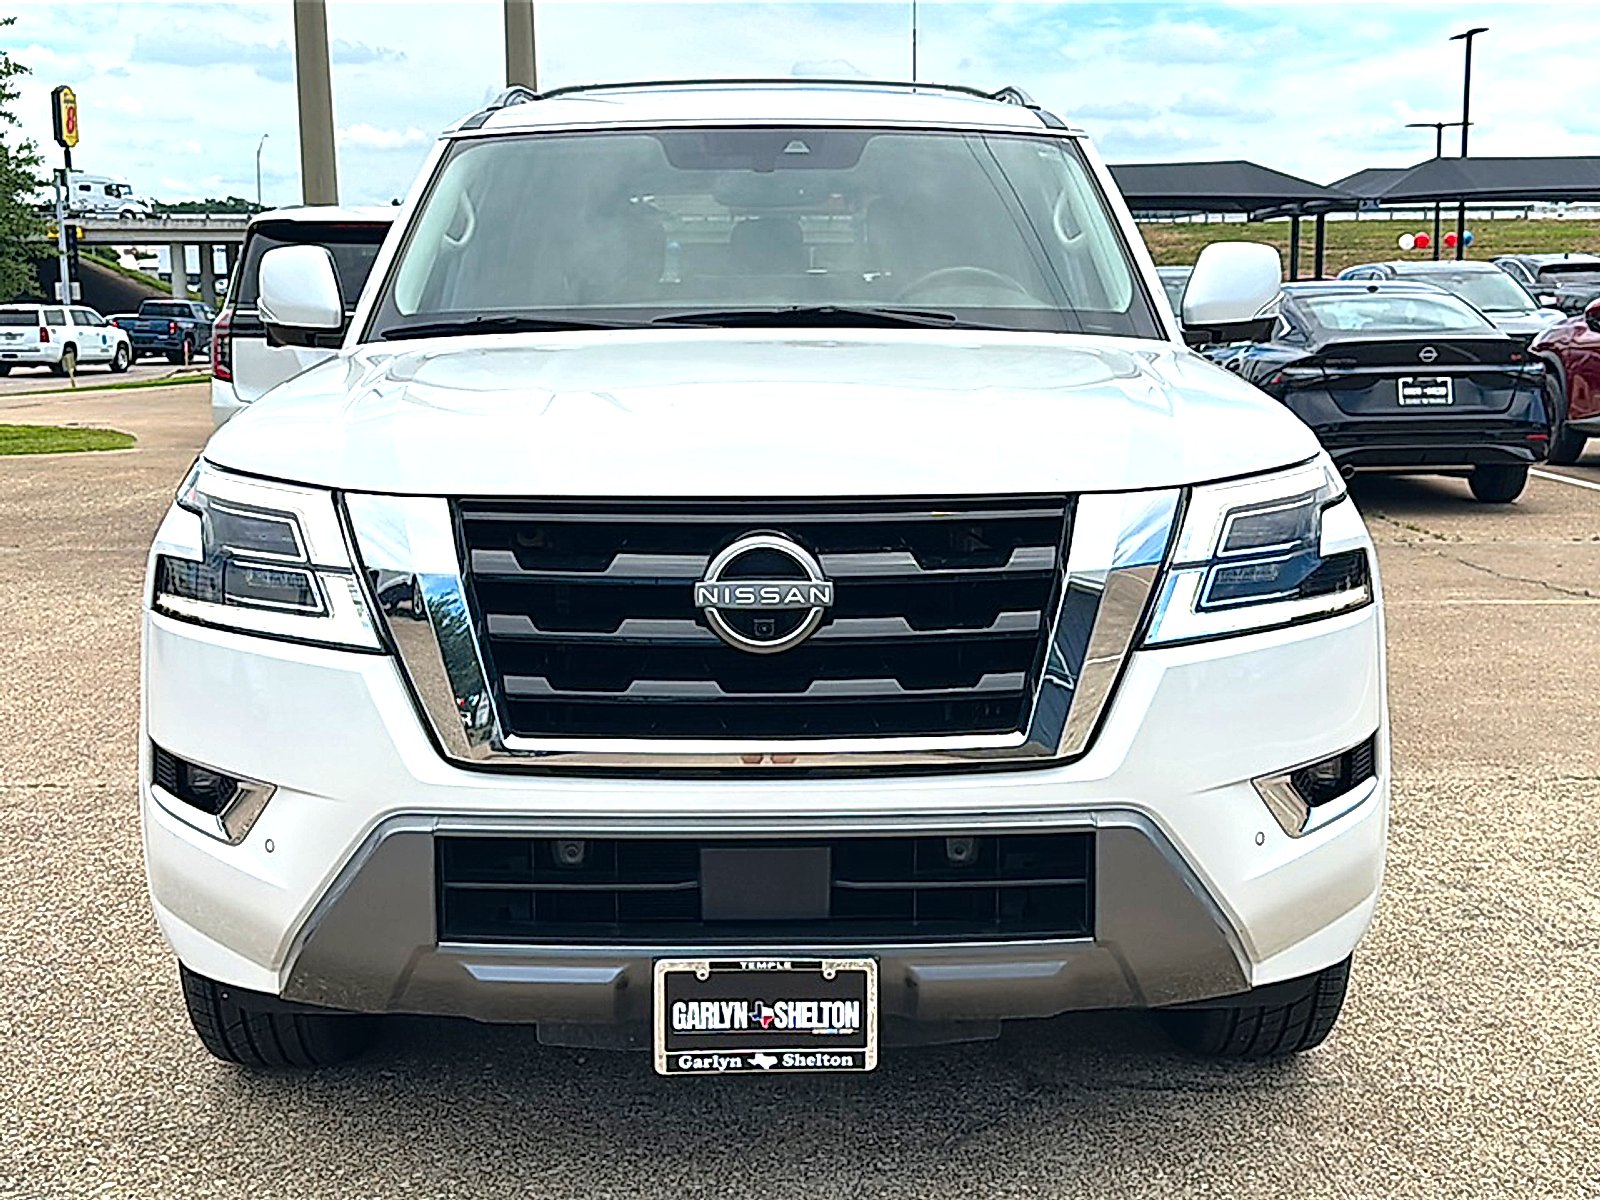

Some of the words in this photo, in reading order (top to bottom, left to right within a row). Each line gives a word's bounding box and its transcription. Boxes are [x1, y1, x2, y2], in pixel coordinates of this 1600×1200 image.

[66, 106, 76, 135] 8
[699, 586, 830, 604] NISSAN
[740, 961, 792, 970] TEMPLE
[672, 1001, 748, 1030] GARLYN
[774, 1001, 860, 1030] SHELTON
[678, 1054, 742, 1071] Garlyn
[781, 1053, 853, 1067] Shelton
